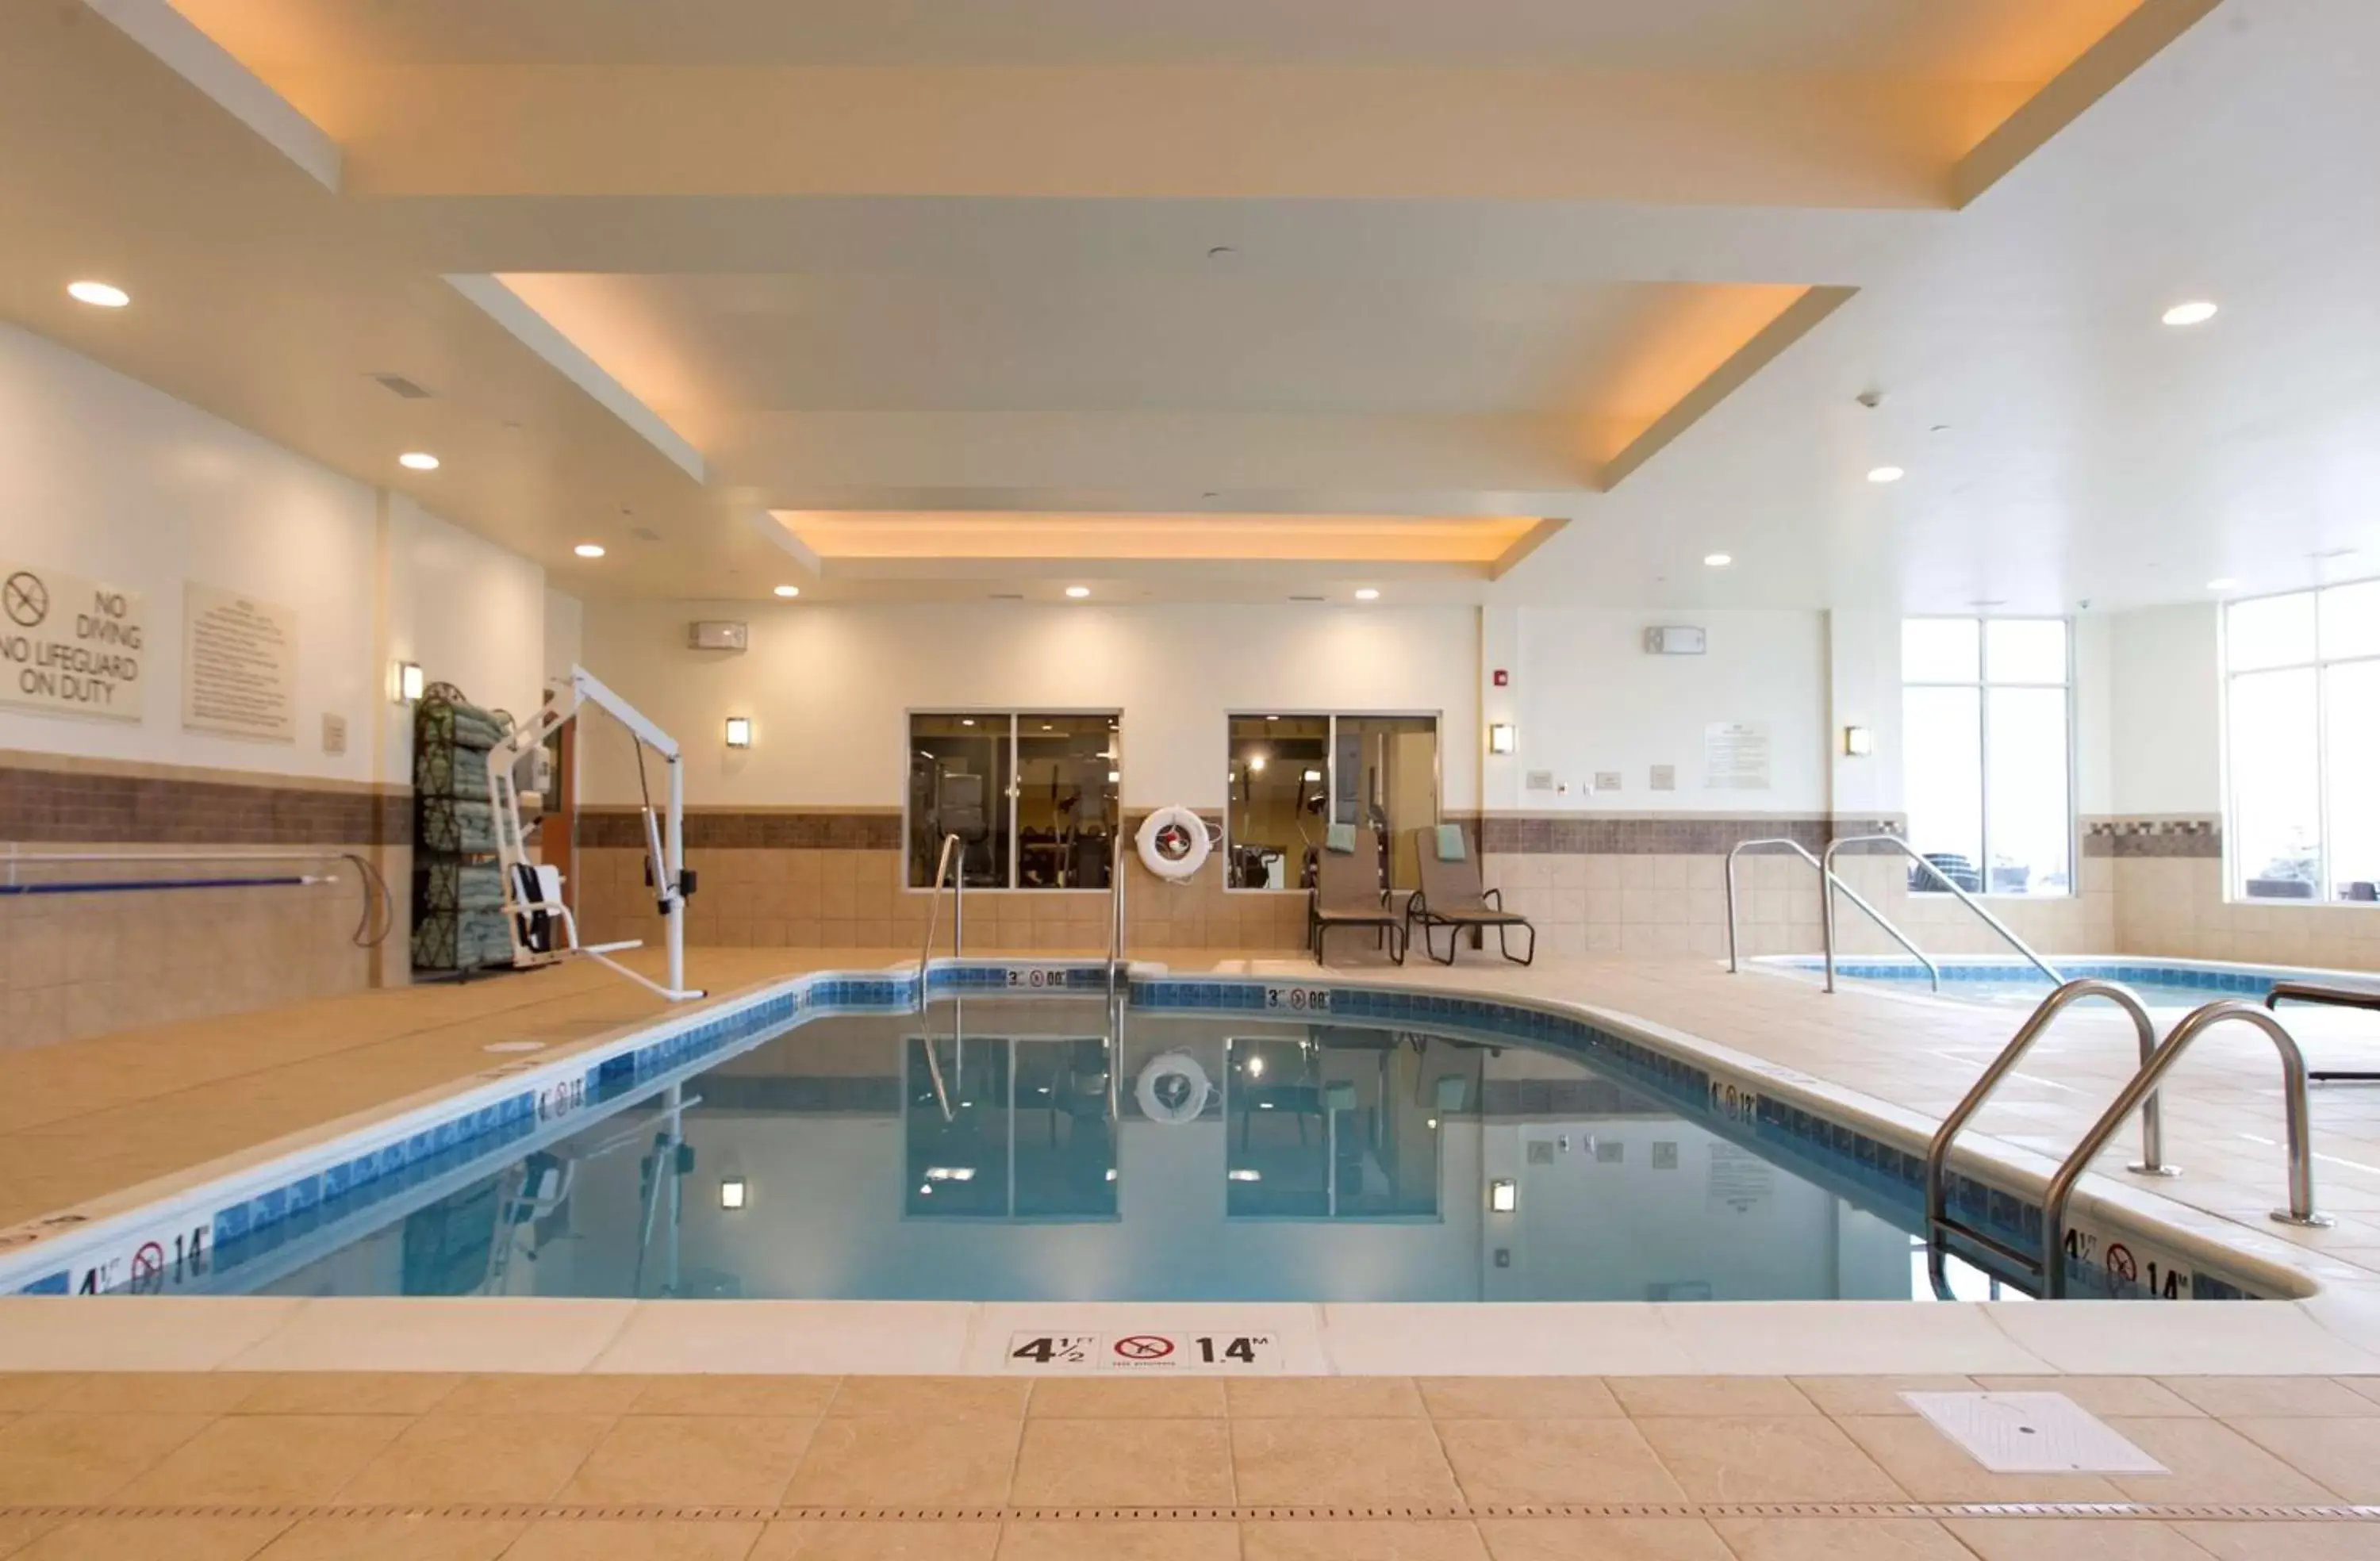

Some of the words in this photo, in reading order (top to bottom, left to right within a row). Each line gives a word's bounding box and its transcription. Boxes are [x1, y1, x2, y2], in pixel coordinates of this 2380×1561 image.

[94, 590, 127, 619] NO
[76, 613, 142, 650] DIVING
[0, 635, 30, 663] NO
[36, 641, 138, 681] LIFEGUARD
[20, 668, 55, 696] ON
[61, 673, 117, 705] DUTY
